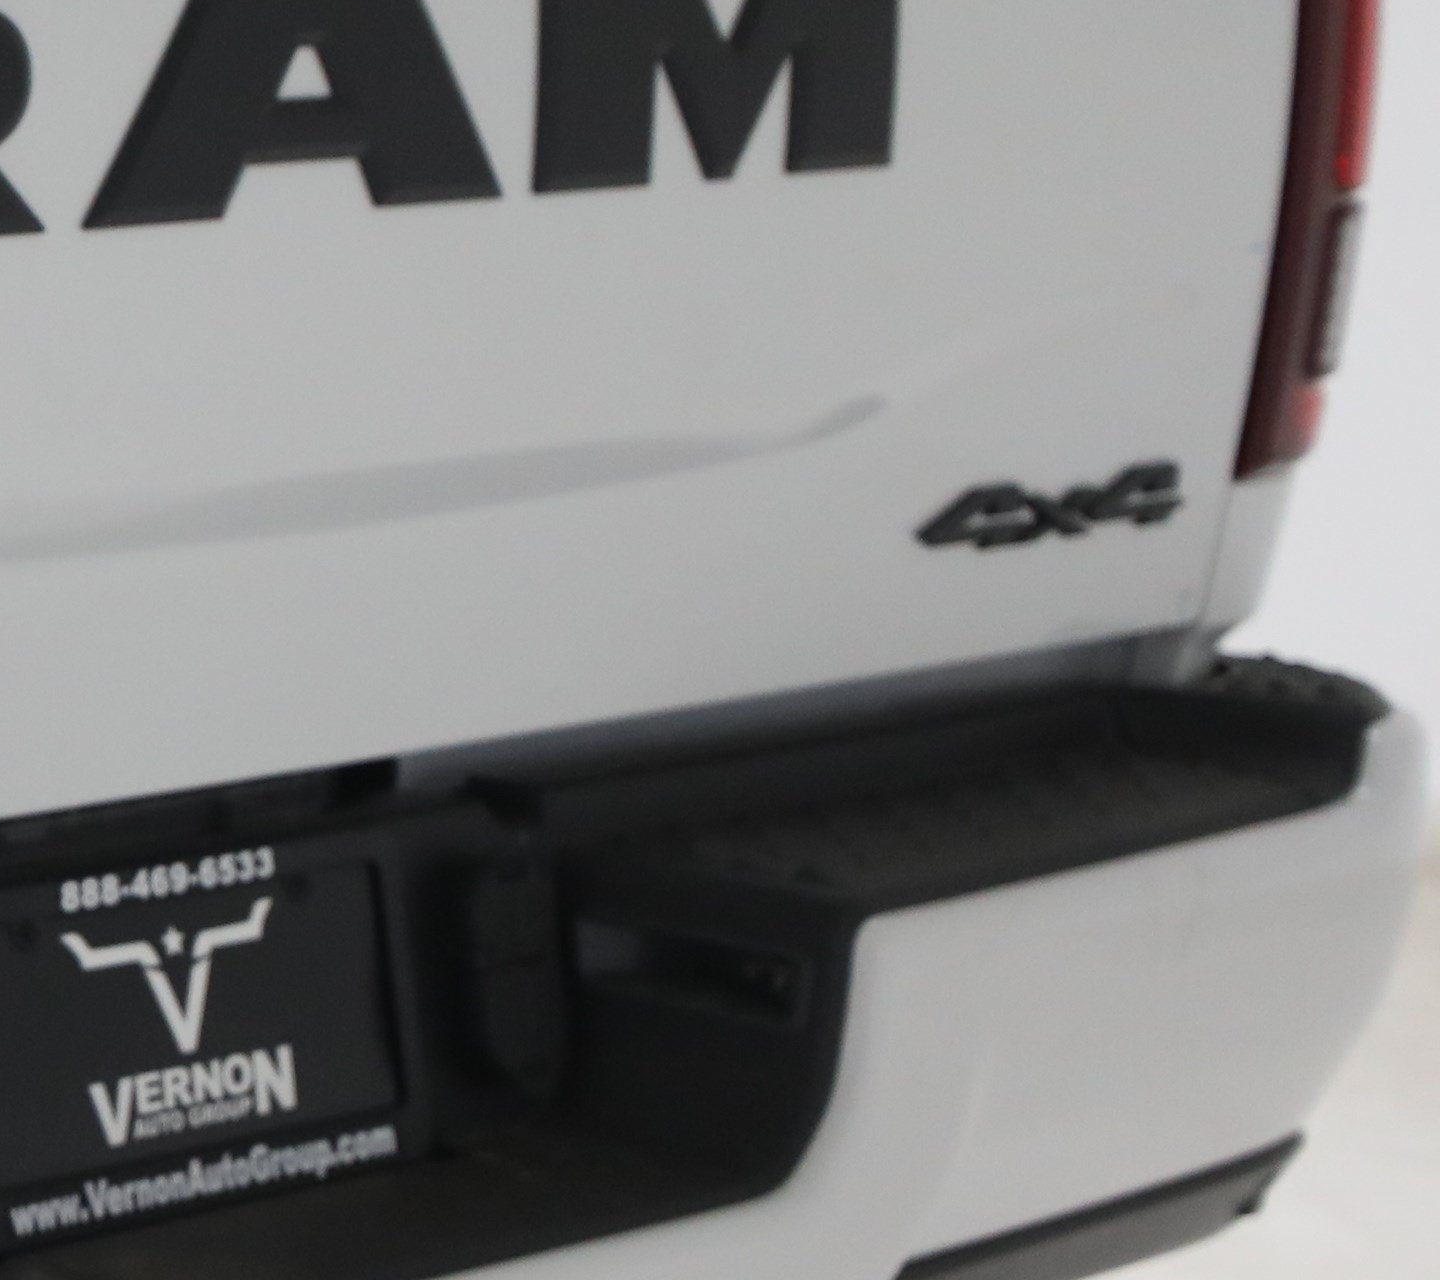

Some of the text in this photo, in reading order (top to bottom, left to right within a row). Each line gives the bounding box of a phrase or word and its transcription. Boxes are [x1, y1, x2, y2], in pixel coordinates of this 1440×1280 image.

[60, 846, 276, 914] 888-469-6533
[88, 1043, 299, 1149] VERNON
[10, 1123, 398, 1238] www.VernonAutoGroup.com
